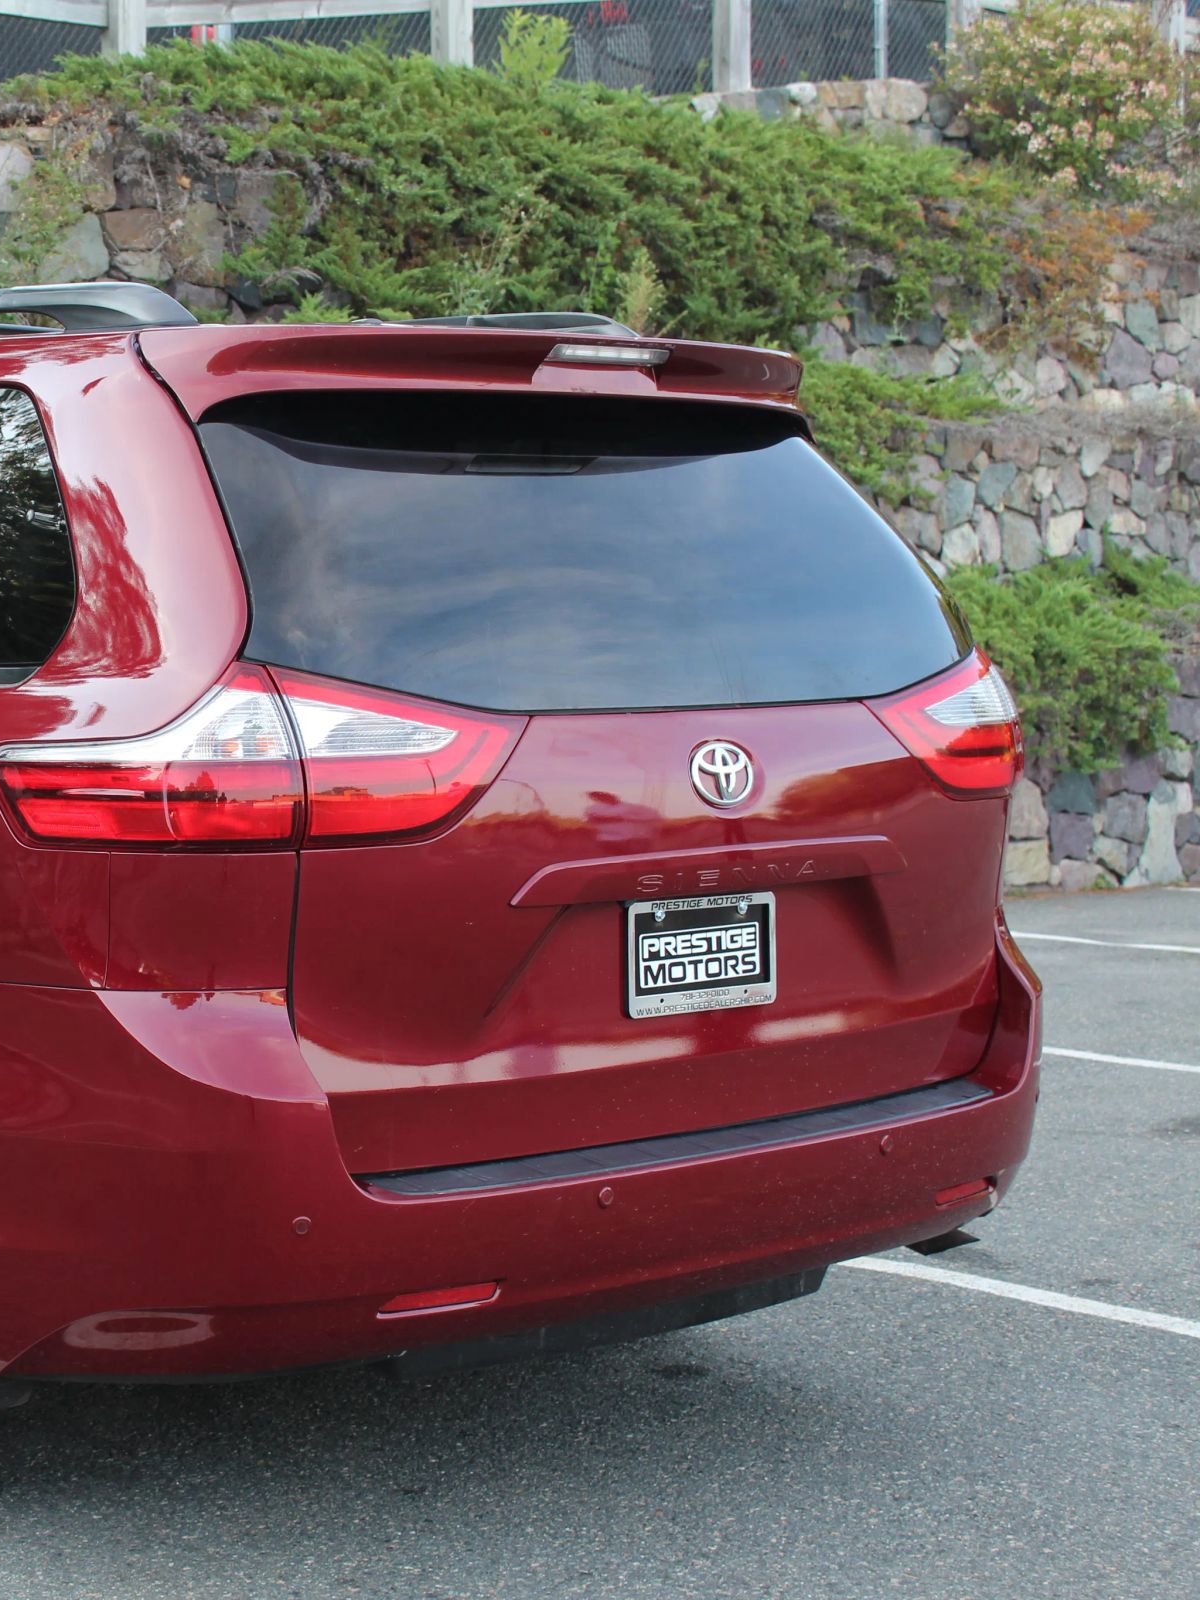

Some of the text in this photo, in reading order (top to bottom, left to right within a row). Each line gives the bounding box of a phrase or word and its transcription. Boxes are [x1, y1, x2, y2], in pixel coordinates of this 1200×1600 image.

[637, 860, 814, 892] SIENNA
[651, 895, 753, 911] PRESTIGE MOTORS
[642, 927, 756, 959] PRESTIGE
[643, 953, 757, 985] MOTORS
[636, 994, 772, 1016] WWW.PRESTIGEDEALERSHIP.COM
